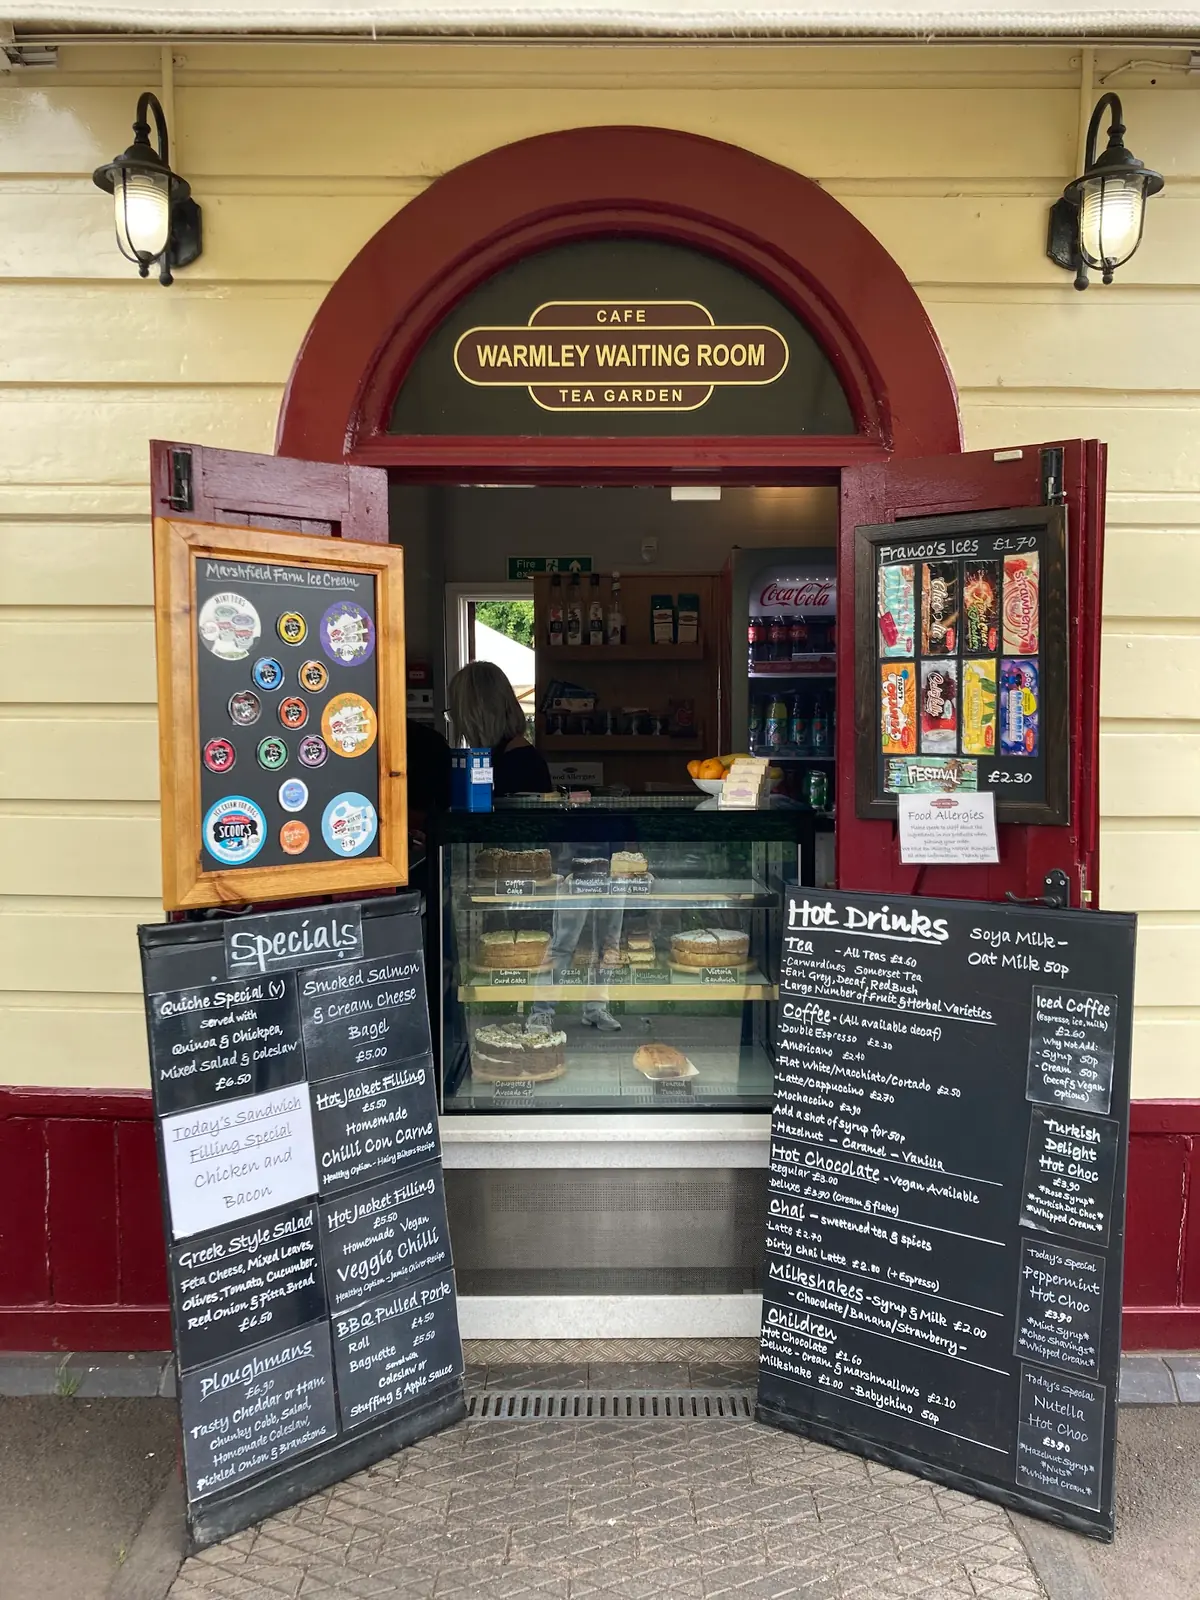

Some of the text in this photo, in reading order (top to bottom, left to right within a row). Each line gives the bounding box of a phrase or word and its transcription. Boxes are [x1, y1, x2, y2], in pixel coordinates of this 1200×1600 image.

[597, 310, 646, 322] CAFE
[476, 344, 765, 367] WARMLEY WAITING ROOM
[560, 389, 683, 402] TEA GARDEN
[516, 559, 535, 569] Fire
[879, 537, 1037, 566] Franco's Ices £1.70
[206, 563, 359, 588] Marshfield Farm Ice Cream
[759, 582, 834, 607] Coca-Cola
[907, 765, 961, 785] FESTIVAL
[988, 770, 1033, 784] £2.30
[908, 810, 985, 822] Food Allergies
[788, 899, 949, 941] Hot Drinks
[230, 920, 358, 971] Specials
[784, 936, 814, 953] Tea
[969, 927, 1011, 948] Soya
[843, 946, 887, 963] All Teas
[967, 952, 1070, 979] Oat Milk 50p
[303, 963, 420, 996] Smoked Salmon
[706, 967, 732, 975] Victoria
[854, 965, 924, 983] Somerset Tea
[160, 986, 264, 1016] Quiche Special
[327, 987, 417, 1019] Cream Cheese
[943, 1003, 993, 1020] Varieties
[1036, 995, 1111, 1019] Iced Coffee
[235, 1009, 258, 1023] with
[348, 1018, 390, 1041] Bagel
[783, 1002, 907, 1034] Coffee available
[171, 1038, 218, 1056] Quinoa
[815, 1028, 893, 1051] Espresso £2.30
[1055, 1027, 1086, 1039] £2.60
[160, 1054, 238, 1080] Mixed Salad
[355, 1046, 388, 1063] £5.00
[215, 1074, 252, 1092] £6.50
[315, 1068, 426, 1110] Hot Filling
[936, 1085, 961, 1098] £2.50
[172, 1096, 302, 1142] Today's Sandwich
[362, 1099, 388, 1113] £5.50
[345, 1108, 408, 1136] Homemade
[773, 1104, 869, 1138] Add syrup
[1043, 1118, 1101, 1144] Turkish
[189, 1123, 292, 1161] Filling Special
[321, 1122, 434, 1168] Chilli Con Carne
[842, 1135, 945, 1172] Caramel Vanilla
[1044, 1137, 1098, 1162] Delight
[194, 1148, 293, 1187] Chicken and
[772, 1143, 981, 1204] Hot Chocolate Available
[811, 1172, 839, 1186] £3.00
[1039, 1154, 1100, 1182] Hot Choc
[222, 1184, 273, 1209] Bacon
[327, 1178, 436, 1230] Hot Jacket Filling
[343, 1214, 431, 1255] Homemade Vegan
[372, 1212, 398, 1229] £5.50
[769, 1198, 932, 1250] Chai sweetened spices
[178, 1210, 314, 1268] Greek Style Salad
[795, 1228, 822, 1242] £2.70
[337, 1227, 439, 1282] Veggie Chilli
[820, 1249, 847, 1266] Latte
[1063, 1258, 1097, 1273] Special
[180, 1253, 280, 1293] Feta Mixed
[1022, 1265, 1101, 1295] Peppermint
[336, 1282, 452, 1339] BBQ Pulled Pork
[768, 1262, 988, 1340] Milkshakes Milk £2.00
[1029, 1285, 1091, 1313] Hot Choc
[187, 1301, 249, 1330] Red Onion
[238, 1311, 273, 1332] £6.50
[766, 1307, 839, 1344] Children
[348, 1336, 370, 1354] Roll
[349, 1330, 437, 1372] Baguette £5.50
[782, 1329, 863, 1366] Chocolate £1.60
[200, 1340, 315, 1397] Ploughmans
[760, 1354, 844, 1390] Milkshake £1.00
[350, 1363, 453, 1417] Stuffing Apple Sauce
[843, 1366, 957, 1410] marshmallows £2.10
[190, 1392, 283, 1439] Tasty Cheddar
[1034, 1394, 1086, 1422] Nutella
[209, 1427, 253, 1450] Chunky
[212, 1435, 268, 1467] Homemade
[196, 1425, 327, 1491] Pickled Branstons
